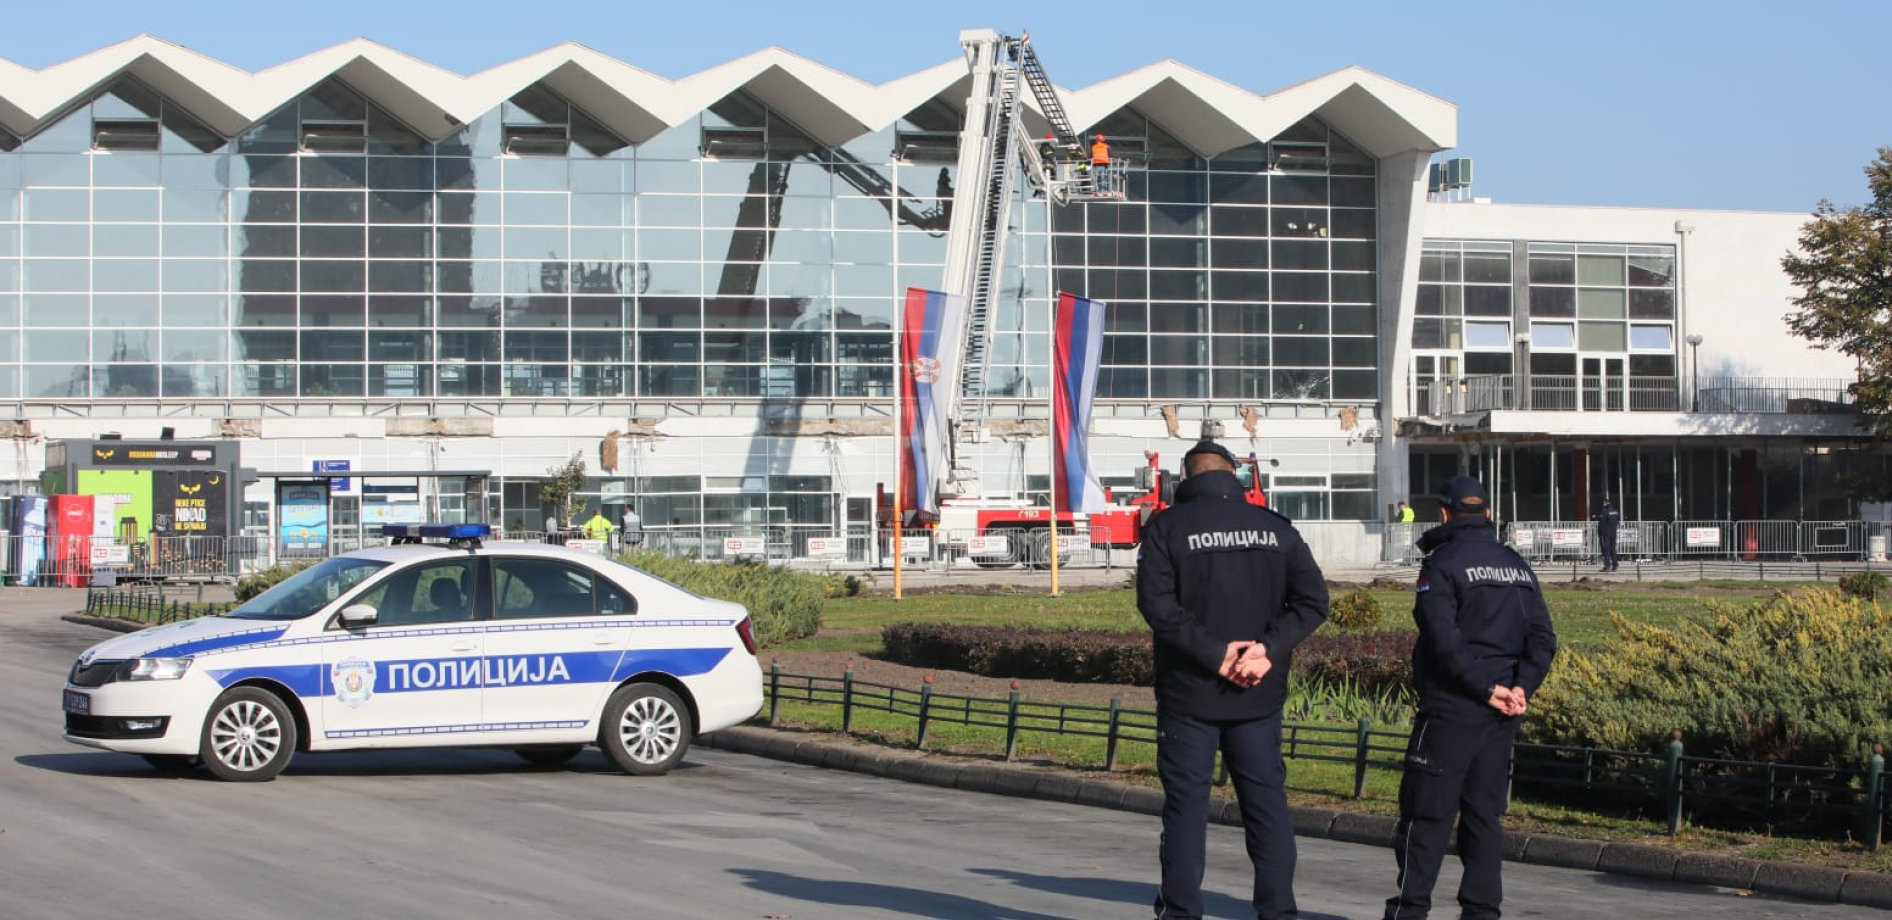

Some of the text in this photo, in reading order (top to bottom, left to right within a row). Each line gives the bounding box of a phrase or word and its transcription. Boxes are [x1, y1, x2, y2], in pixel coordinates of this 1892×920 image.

[175, 508, 207, 522] NIKAD
[1188, 530, 1278, 550] ПОЛИЦИЈА
[1465, 566, 1533, 584] ПОЛИЦИЈА
[388, 656, 570, 689] ПОЛИЦИЈА
